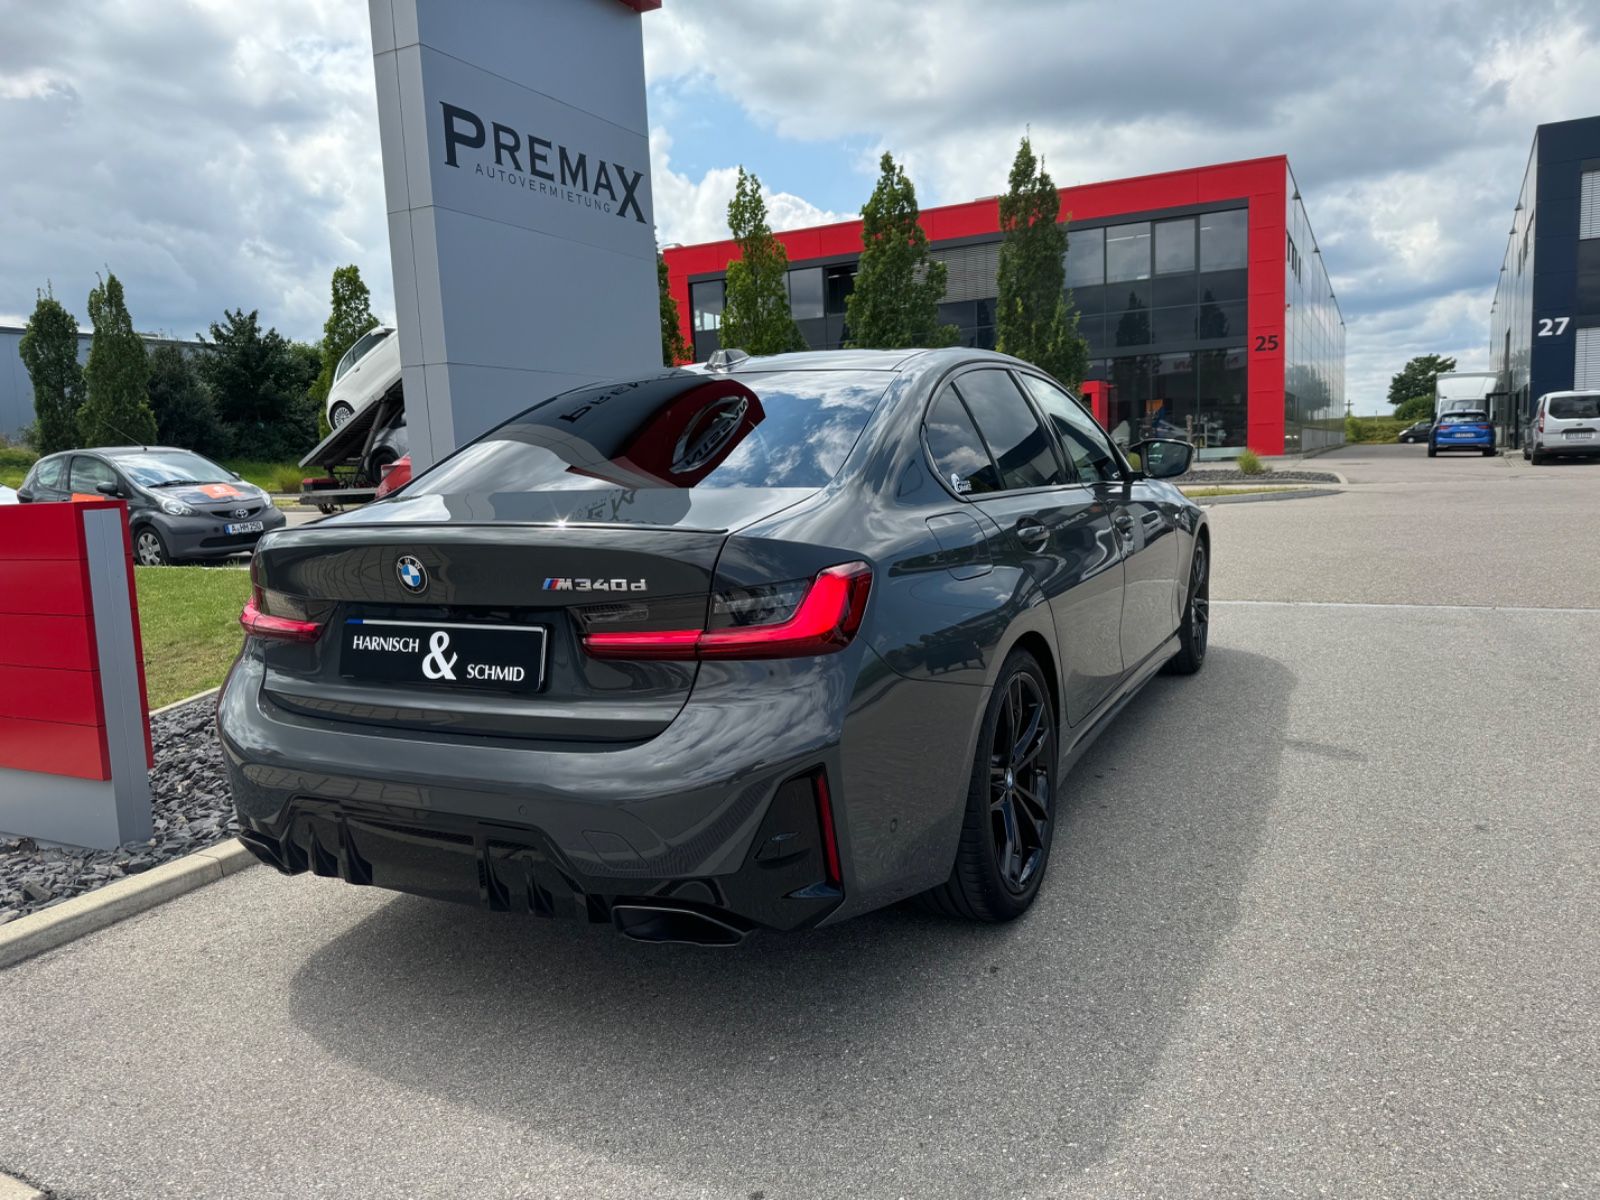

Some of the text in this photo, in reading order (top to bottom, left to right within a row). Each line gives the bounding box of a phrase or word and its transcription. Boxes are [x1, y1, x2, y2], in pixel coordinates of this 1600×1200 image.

[439, 101, 647, 224] PREMAX
[475, 163, 611, 214] AUTOVERMIETUNG
[1537, 317, 1570, 337] 27
[1255, 335, 1279, 351] 25
[353, 635, 419, 653] HARNISCH
[421, 631, 458, 680] &
[466, 664, 525, 682] SCHMID
